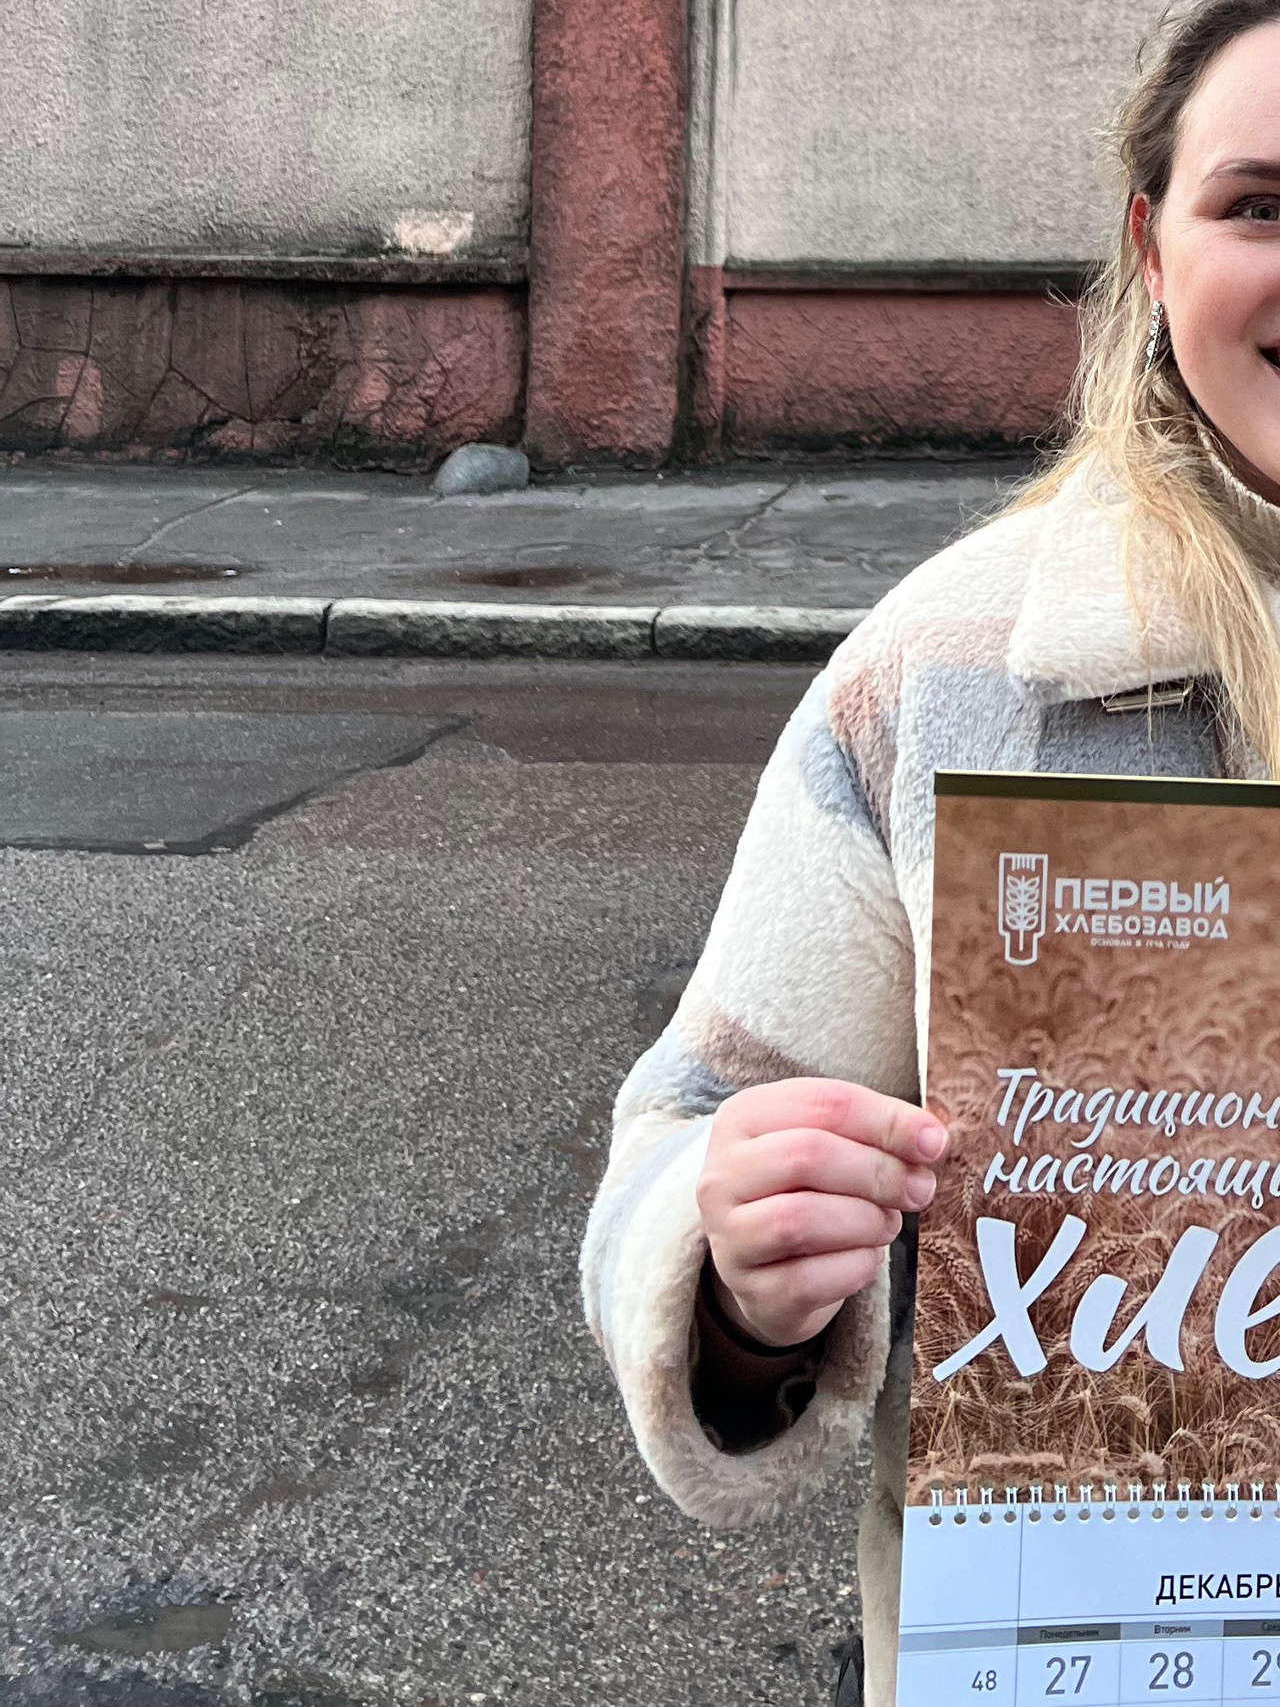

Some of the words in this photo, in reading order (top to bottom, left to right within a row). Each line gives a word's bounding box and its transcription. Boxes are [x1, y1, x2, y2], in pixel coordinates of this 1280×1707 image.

[1053, 875, 1230, 915] ПЕРВЫЙ
[1053, 913, 1229, 940] ХЛЕБОЗАВОД
[1153, 1624, 1192, 1637] Вторник
[971, 1670, 998, 1692] 48
[1045, 1655, 1093, 1696] 27
[1148, 1652, 1195, 1690] 28
